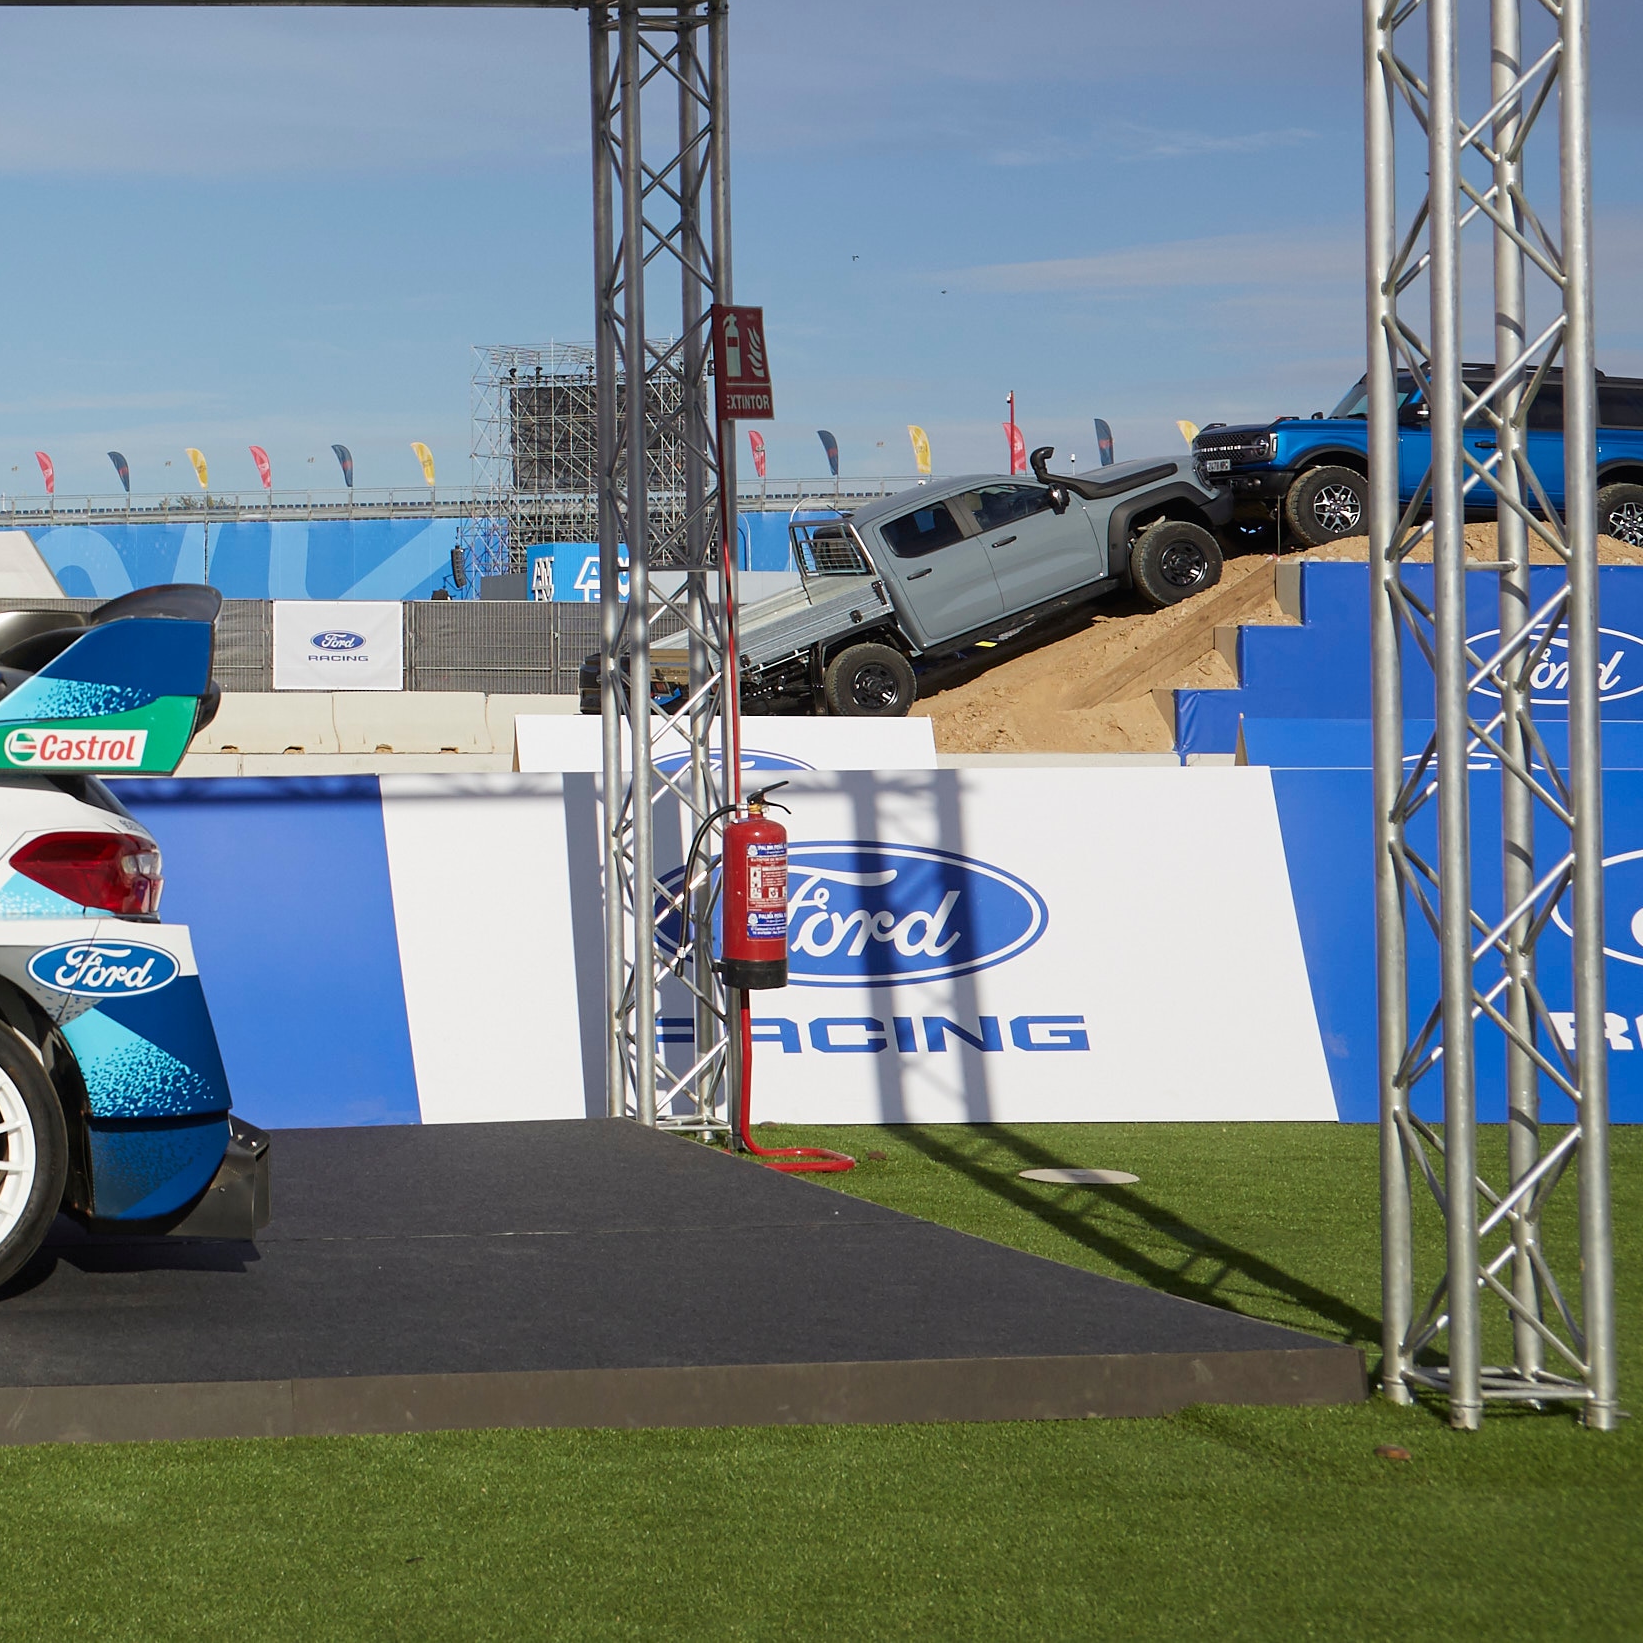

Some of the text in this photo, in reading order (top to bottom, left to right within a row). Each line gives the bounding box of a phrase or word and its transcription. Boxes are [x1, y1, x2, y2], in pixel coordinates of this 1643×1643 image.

[321, 633, 355, 648] Ford
[39, 734, 136, 761] Castrol
[54, 945, 156, 988] Ford
